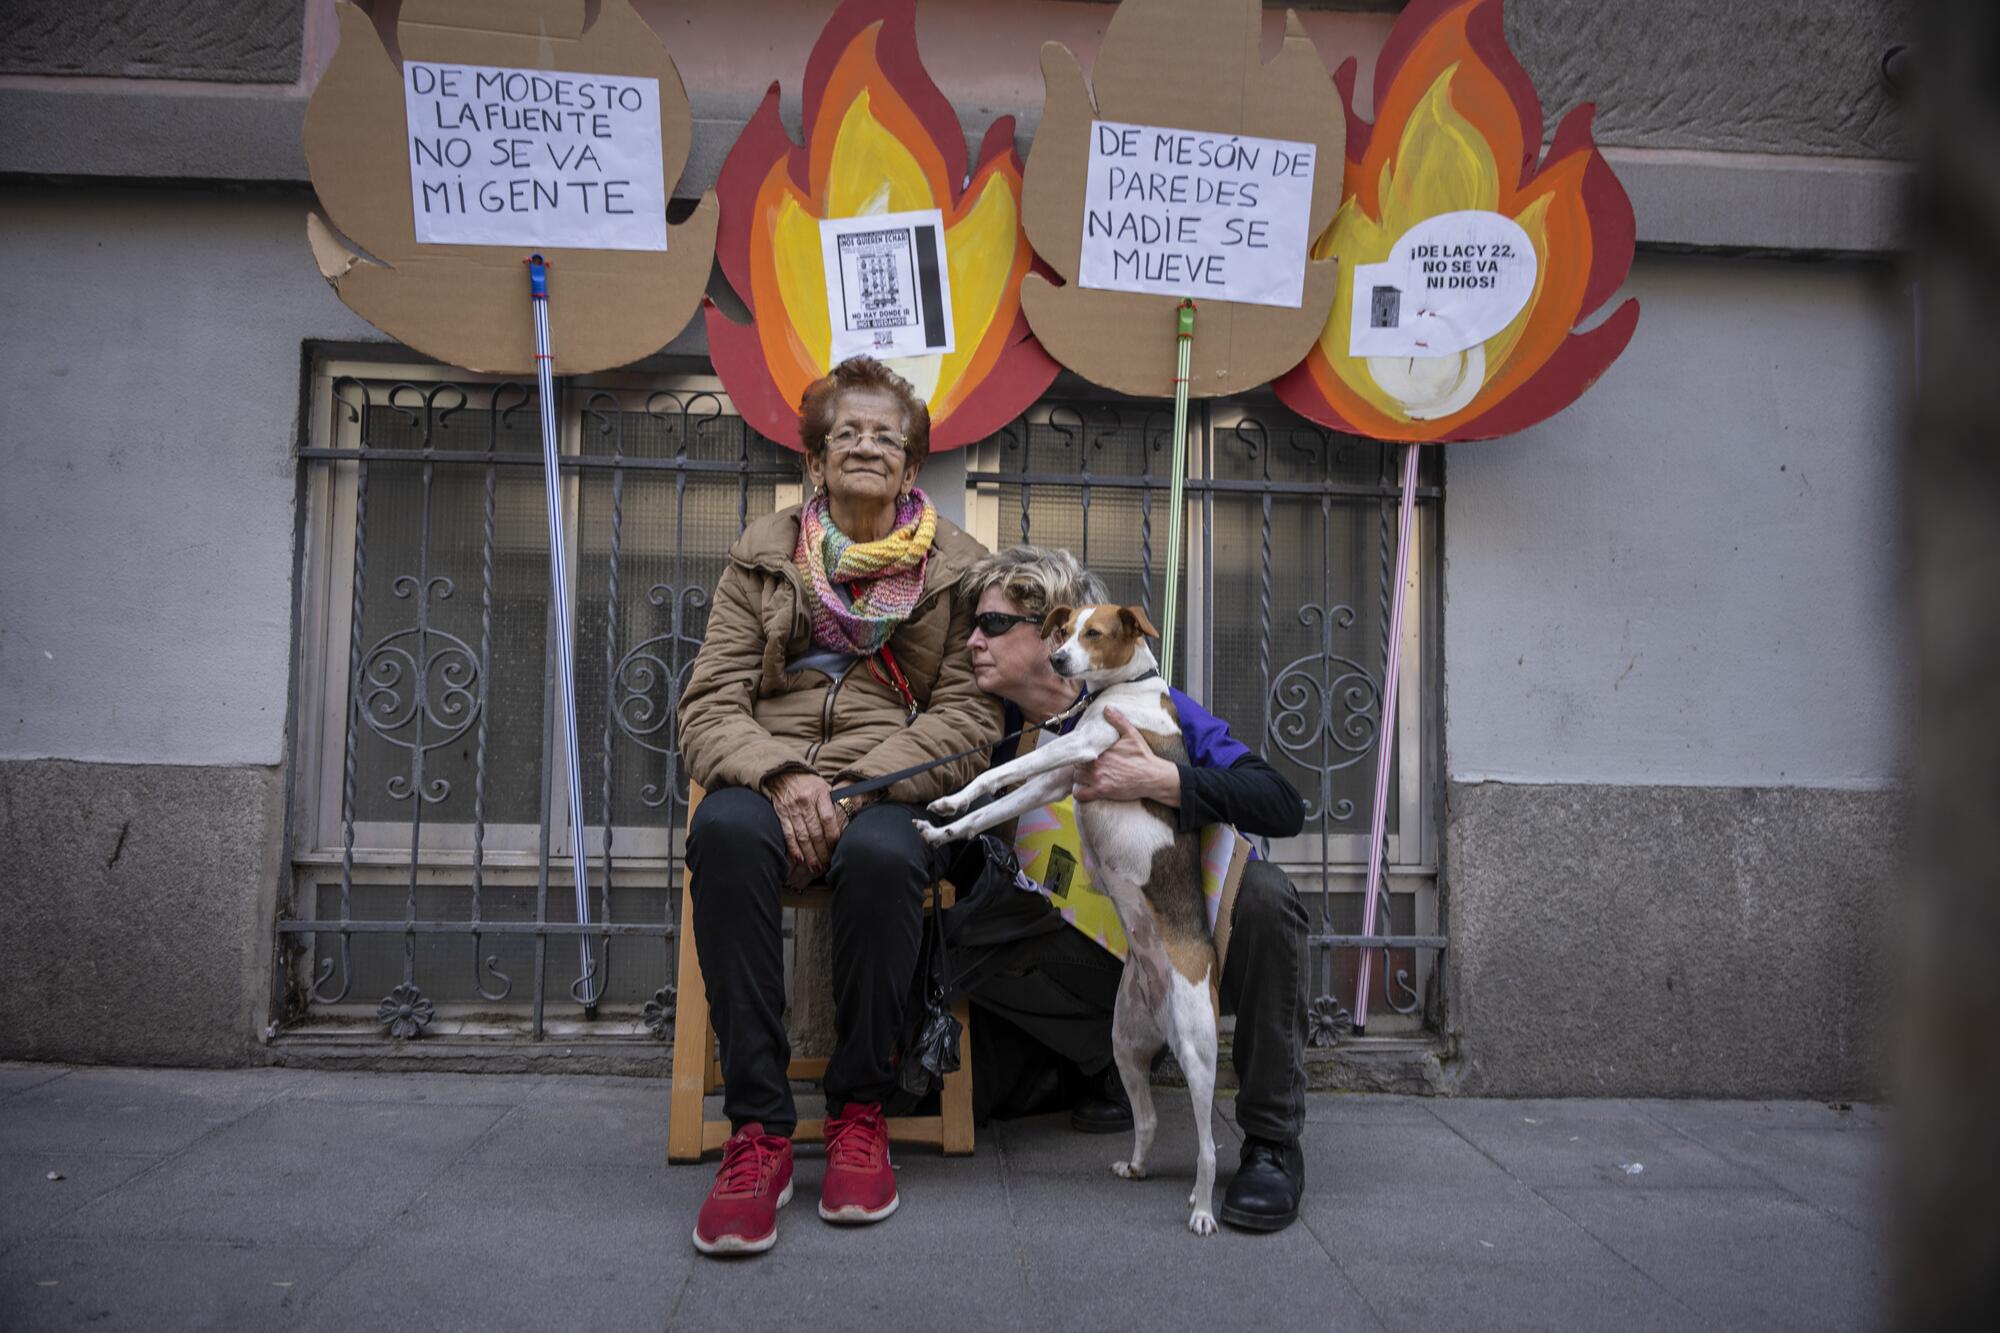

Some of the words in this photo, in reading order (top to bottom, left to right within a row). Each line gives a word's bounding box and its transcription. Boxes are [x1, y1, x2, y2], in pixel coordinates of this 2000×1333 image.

[412, 66, 462, 97] DE
[476, 72, 642, 112] MODESTO
[414, 136, 471, 168] NO
[490, 139, 533, 168] SE
[547, 142, 602, 172] VA
[1099, 125, 1141, 157] DE
[1154, 134, 1260, 172] MESÓN
[1272, 150, 1311, 178] DE
[479, 179, 634, 214] GENTE
[1109, 167, 1259, 207] PAREDES
[857, 235, 882, 245] QUIEREN
[1220, 218, 1269, 249] SE
[1112, 249, 1226, 285] MUEVE
[1411, 245, 1439, 260] ¡DE
[1443, 245, 1488, 258] LACY
[1491, 245, 1516, 259] 22,
[1423, 261, 1448, 273] NO
[1451, 261, 1472, 273] SE
[1476, 261, 1499, 273] VA
[1427, 276, 1445, 289] NI
[1448, 276, 1495, 289] DIOS!
[879, 309, 901, 318] DONDE
